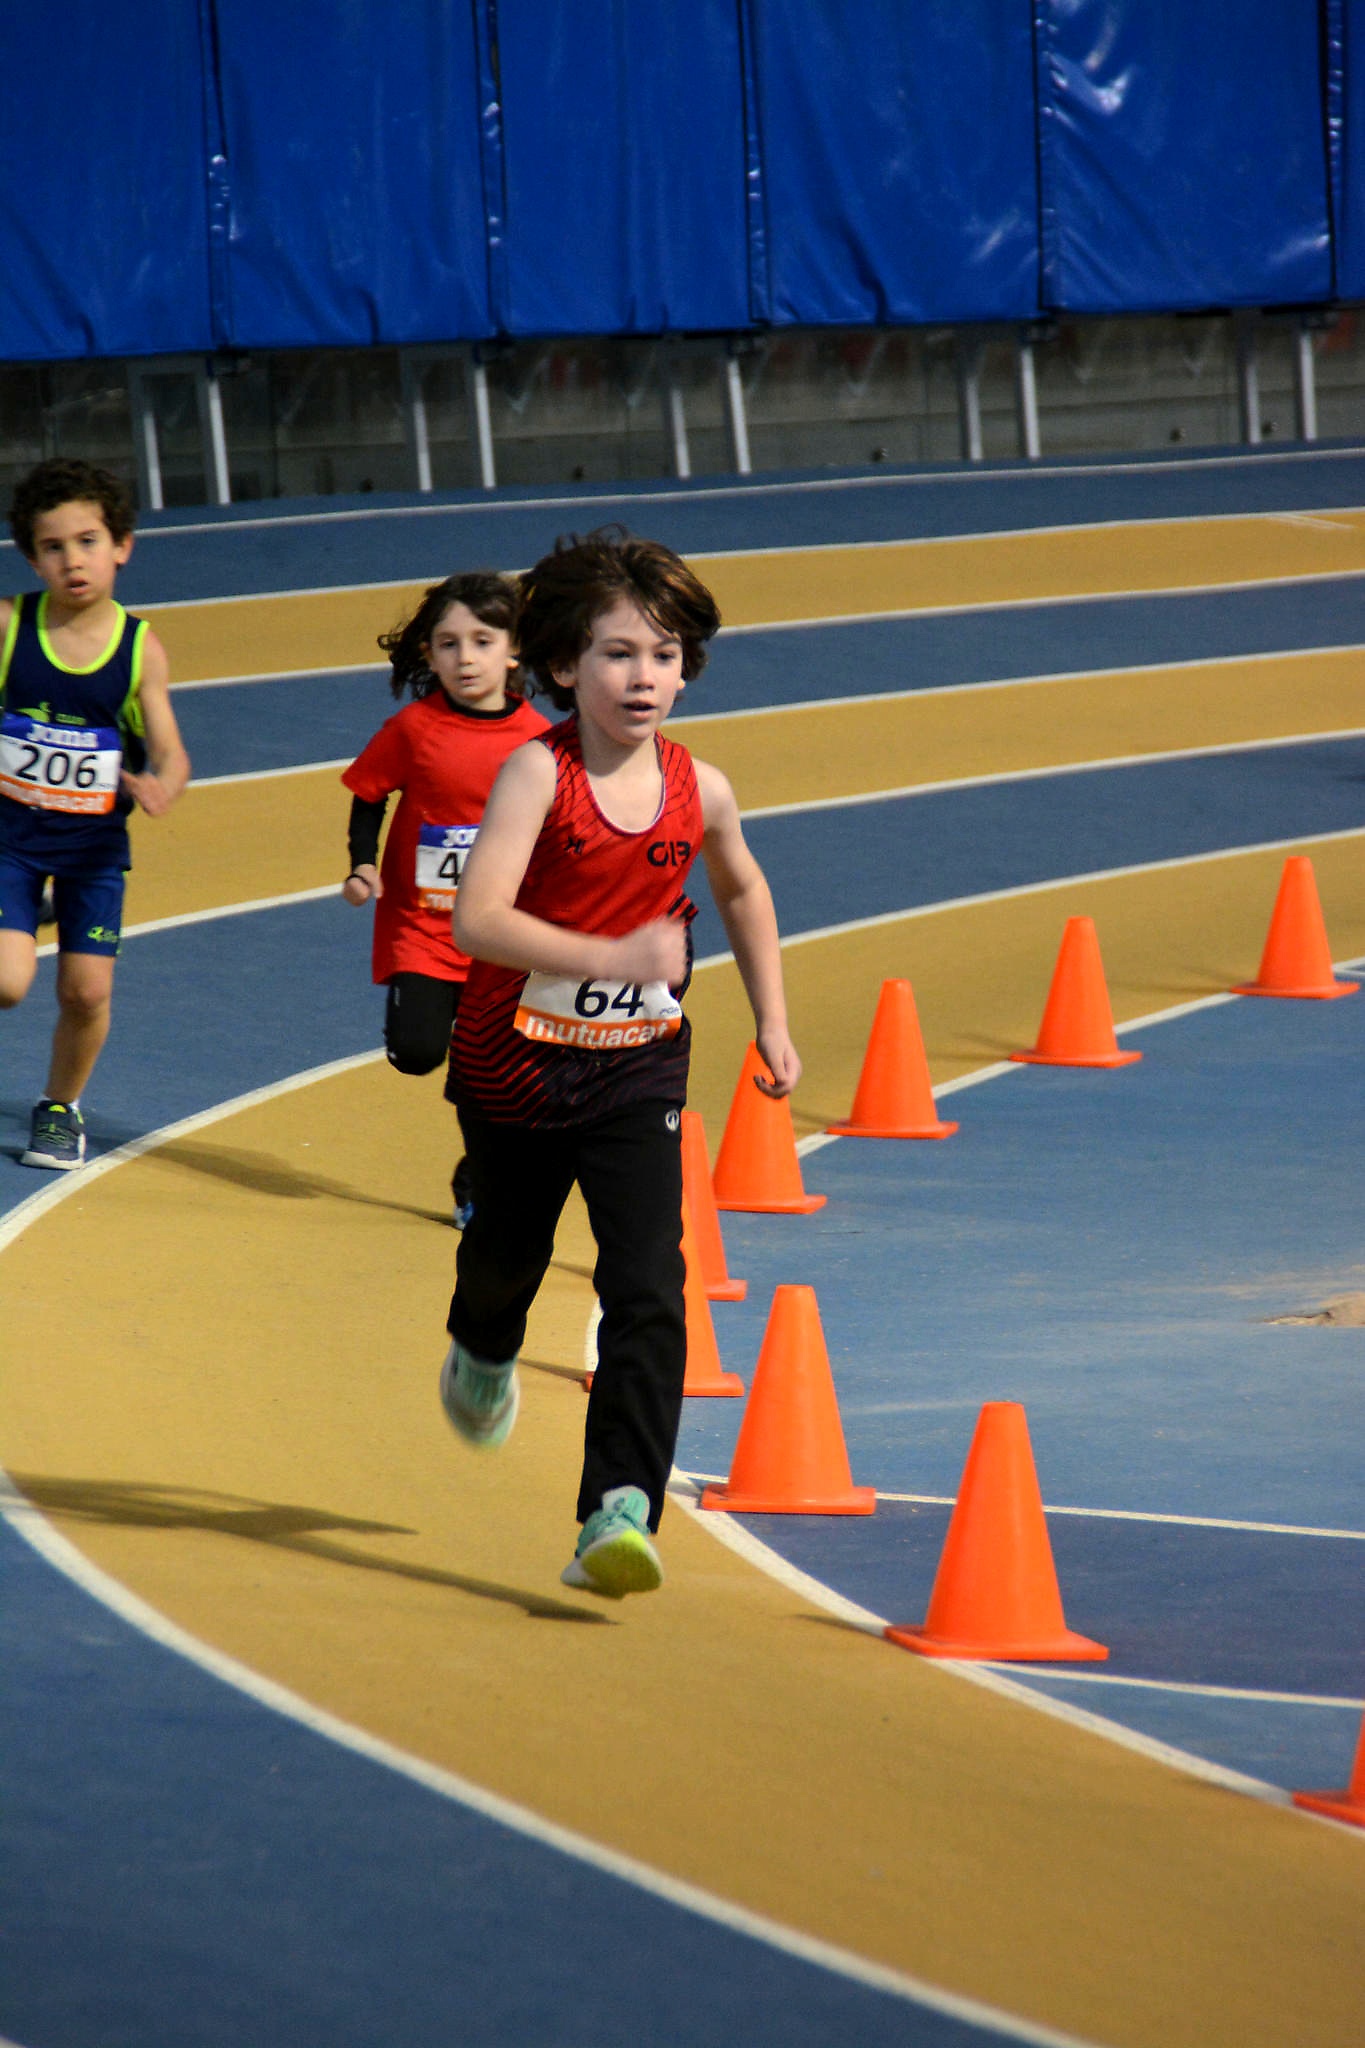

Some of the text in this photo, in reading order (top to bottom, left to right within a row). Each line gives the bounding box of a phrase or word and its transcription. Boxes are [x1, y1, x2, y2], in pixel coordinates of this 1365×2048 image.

[15, 744, 98, 788] 206
[574, 977, 644, 1018] 64
[526, 1015, 669, 1047] mutuacat
